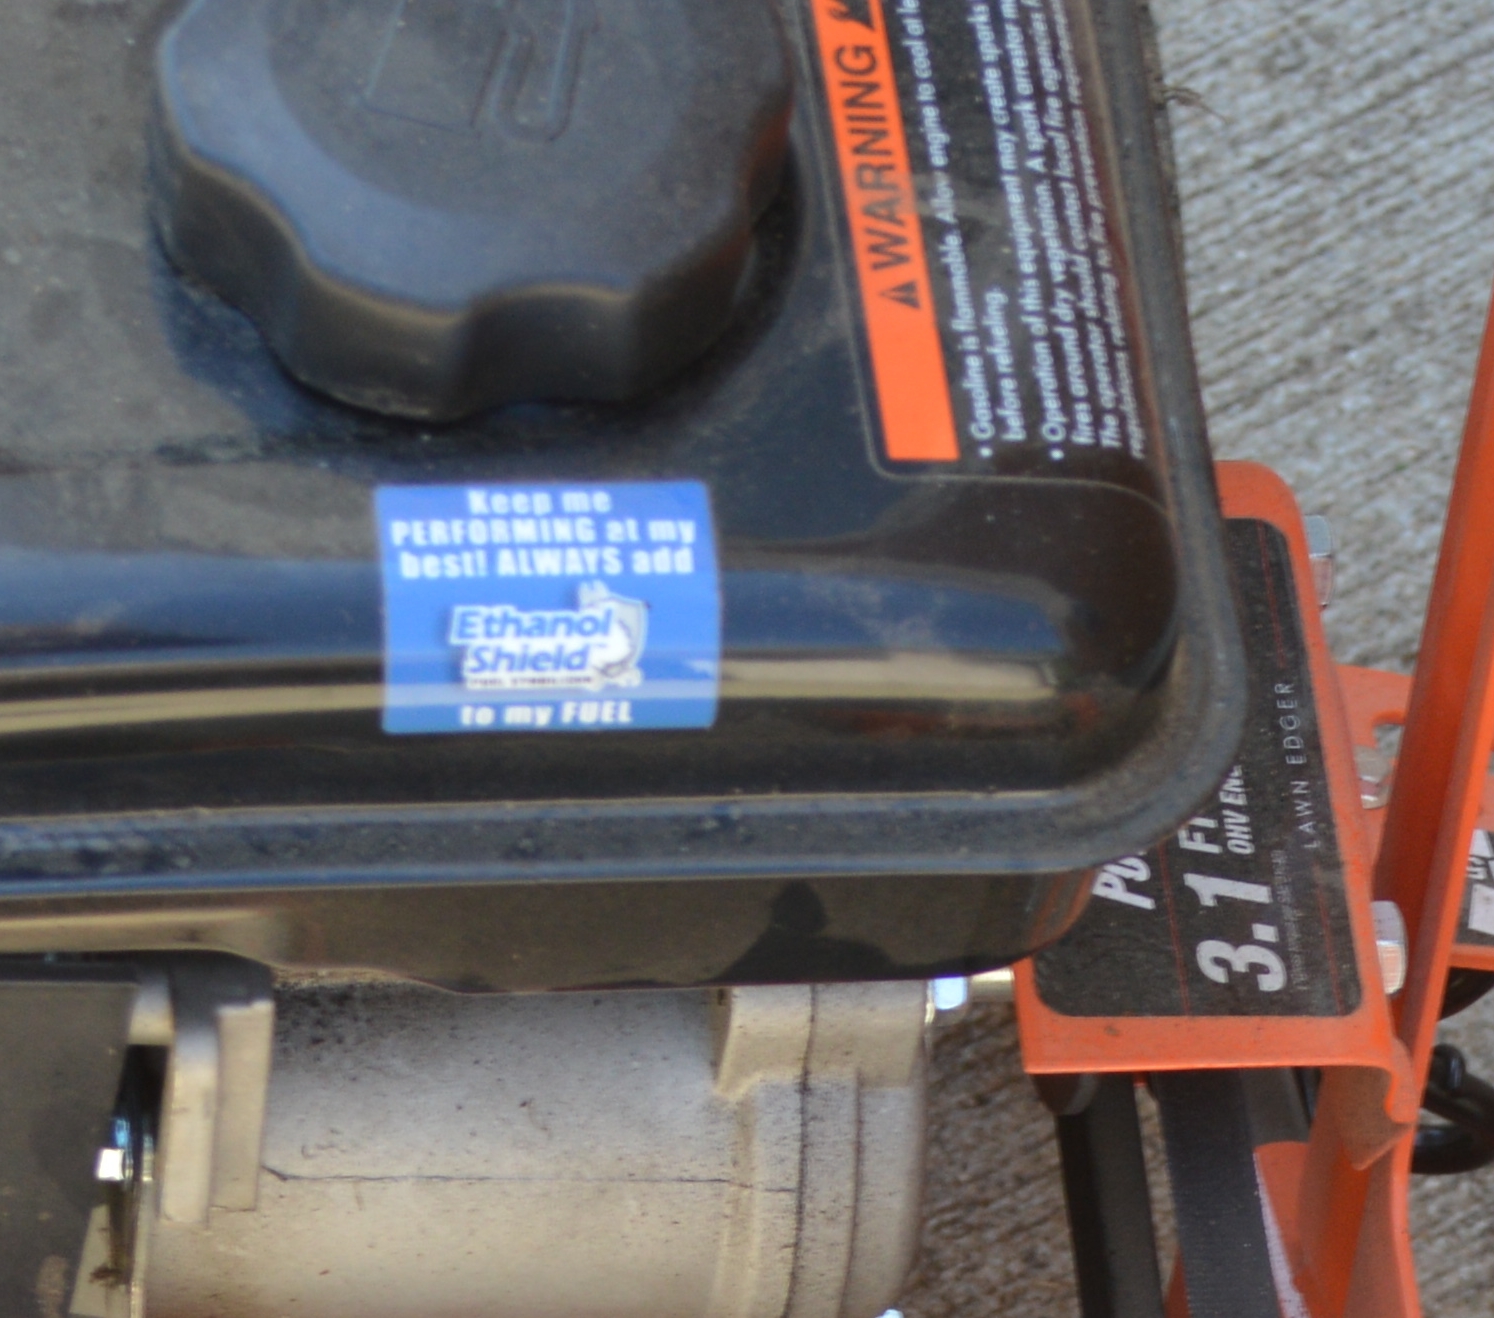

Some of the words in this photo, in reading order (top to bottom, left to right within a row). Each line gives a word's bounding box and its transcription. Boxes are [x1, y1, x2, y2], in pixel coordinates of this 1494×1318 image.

[900, 16, 923, 35] at
[968, 4, 1005, 63] sparks
[900, 41, 932, 78] cool
[1004, 24, 1034, 94] arrestor
[915, 84, 935, 100] to
[983, 69, 1009, 126] create
[1041, 97, 1064, 127] fire
[916, 106, 951, 166] engine
[1013, 101, 1045, 151] spark
[835, 45, 912, 272] WARNING
[996, 131, 1018, 170] may
[1026, 156, 1047, 172] A
[1045, 133, 1073, 178] local
[1004, 176, 1038, 273] equipment
[1016, 279, 1041, 310] this
[1047, 288, 1073, 322] dry
[955, 336, 978, 350] is
[1020, 316, 1046, 334] of
[1053, 326, 1087, 397] around
[1083, 323, 1116, 409] operator
[962, 356, 996, 441] Gasoline
[997, 378, 1026, 441] before
[1026, 341, 1065, 441] Operation
[1068, 403, 1094, 444] fires
[1100, 416, 1124, 448] The
[467, 489, 553, 517] Keep
[561, 490, 612, 513] me
[390, 517, 597, 546] PERFORMING
[606, 519, 640, 543] at
[648, 519, 696, 546] my
[399, 549, 489, 579] best!
[497, 547, 623, 576] ALWAYS
[632, 547, 694, 575] add
[457, 608, 612, 640] Ethanol
[466, 643, 590, 673] Shield
[461, 705, 496, 726] to
[503, 705, 553, 727] my
[561, 700, 634, 724] FUEL
[1274, 682, 1306, 765] EDGER
[1222, 809, 1256, 855] OHV
[1294, 779, 1322, 850] LAWN
[1183, 872, 1288, 992] 3.1
